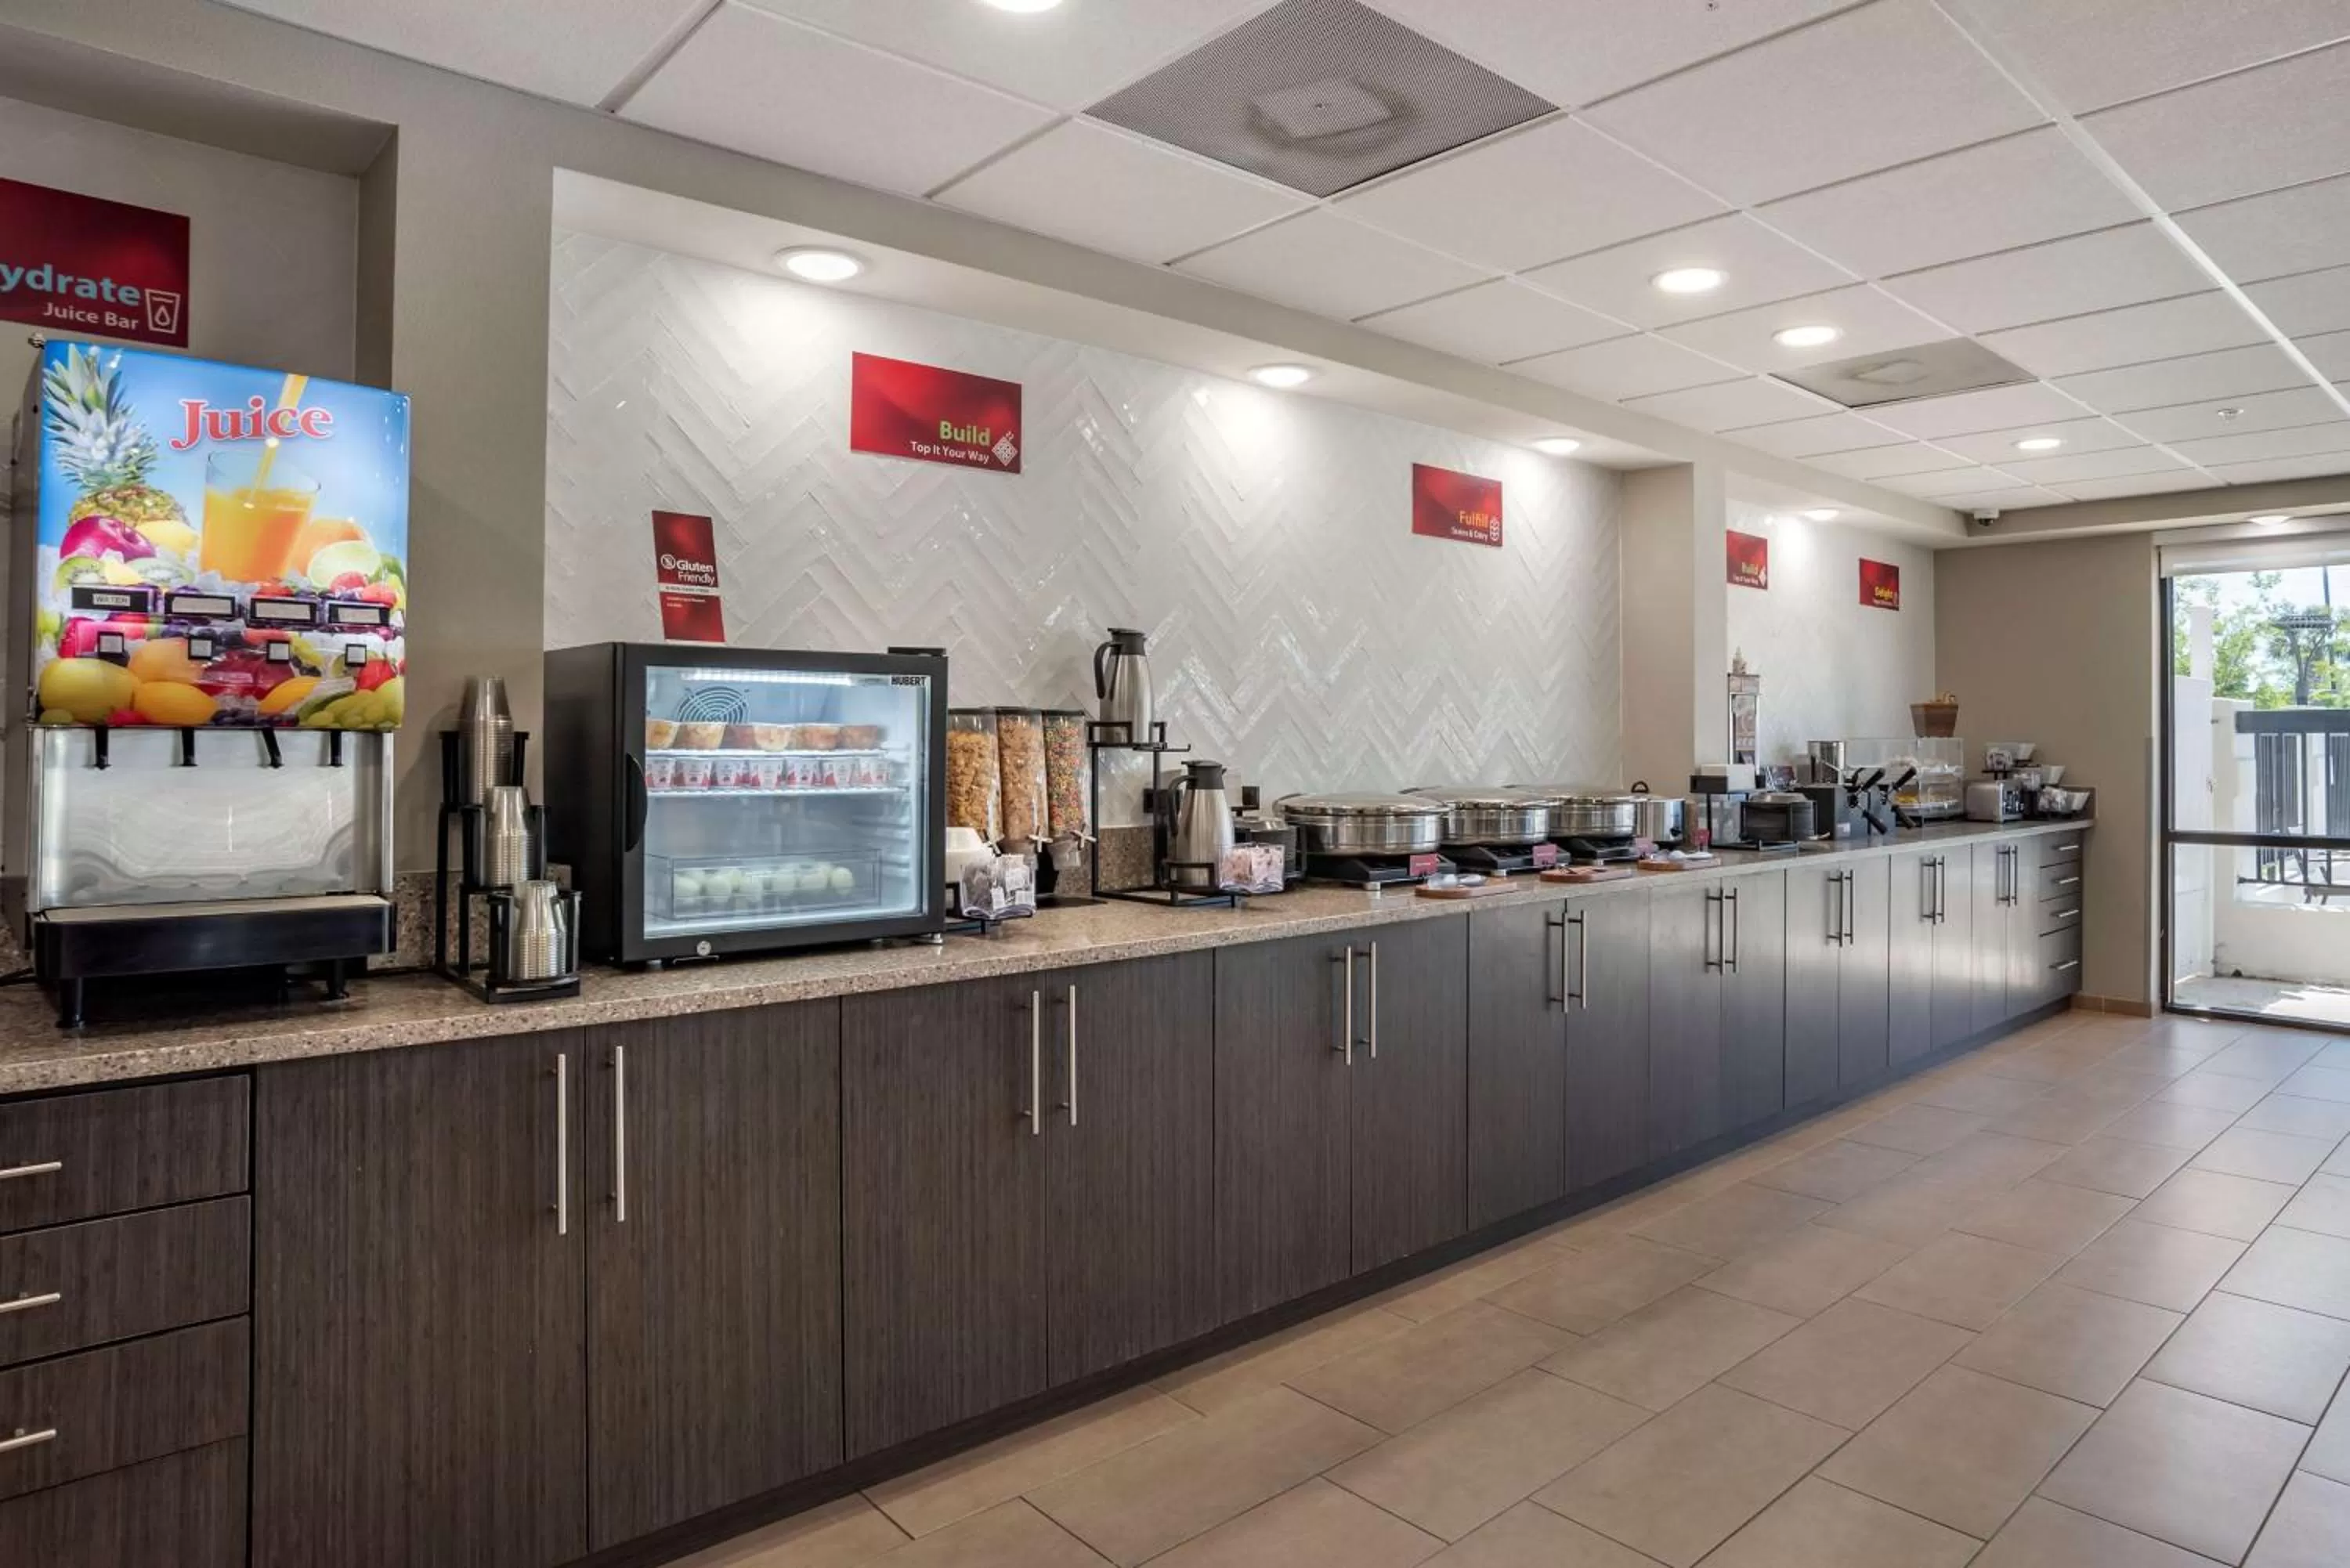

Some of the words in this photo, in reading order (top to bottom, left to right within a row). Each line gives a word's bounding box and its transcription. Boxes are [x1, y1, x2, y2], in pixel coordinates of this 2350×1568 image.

[42, 302, 99, 323] Juice
[104, 311, 139, 330] Bar
[169, 395, 334, 451] Juice
[939, 421, 991, 446] Build
[910, 441, 931, 456] Top
[933, 444, 941, 455] It
[942, 446, 967, 459] Your
[967, 450, 989, 464] Way
[677, 559, 714, 573] Gluten
[678, 571, 715, 587] Friendly
[96, 594, 127, 605] WATER
[891, 676, 926, 686] HUBERT
